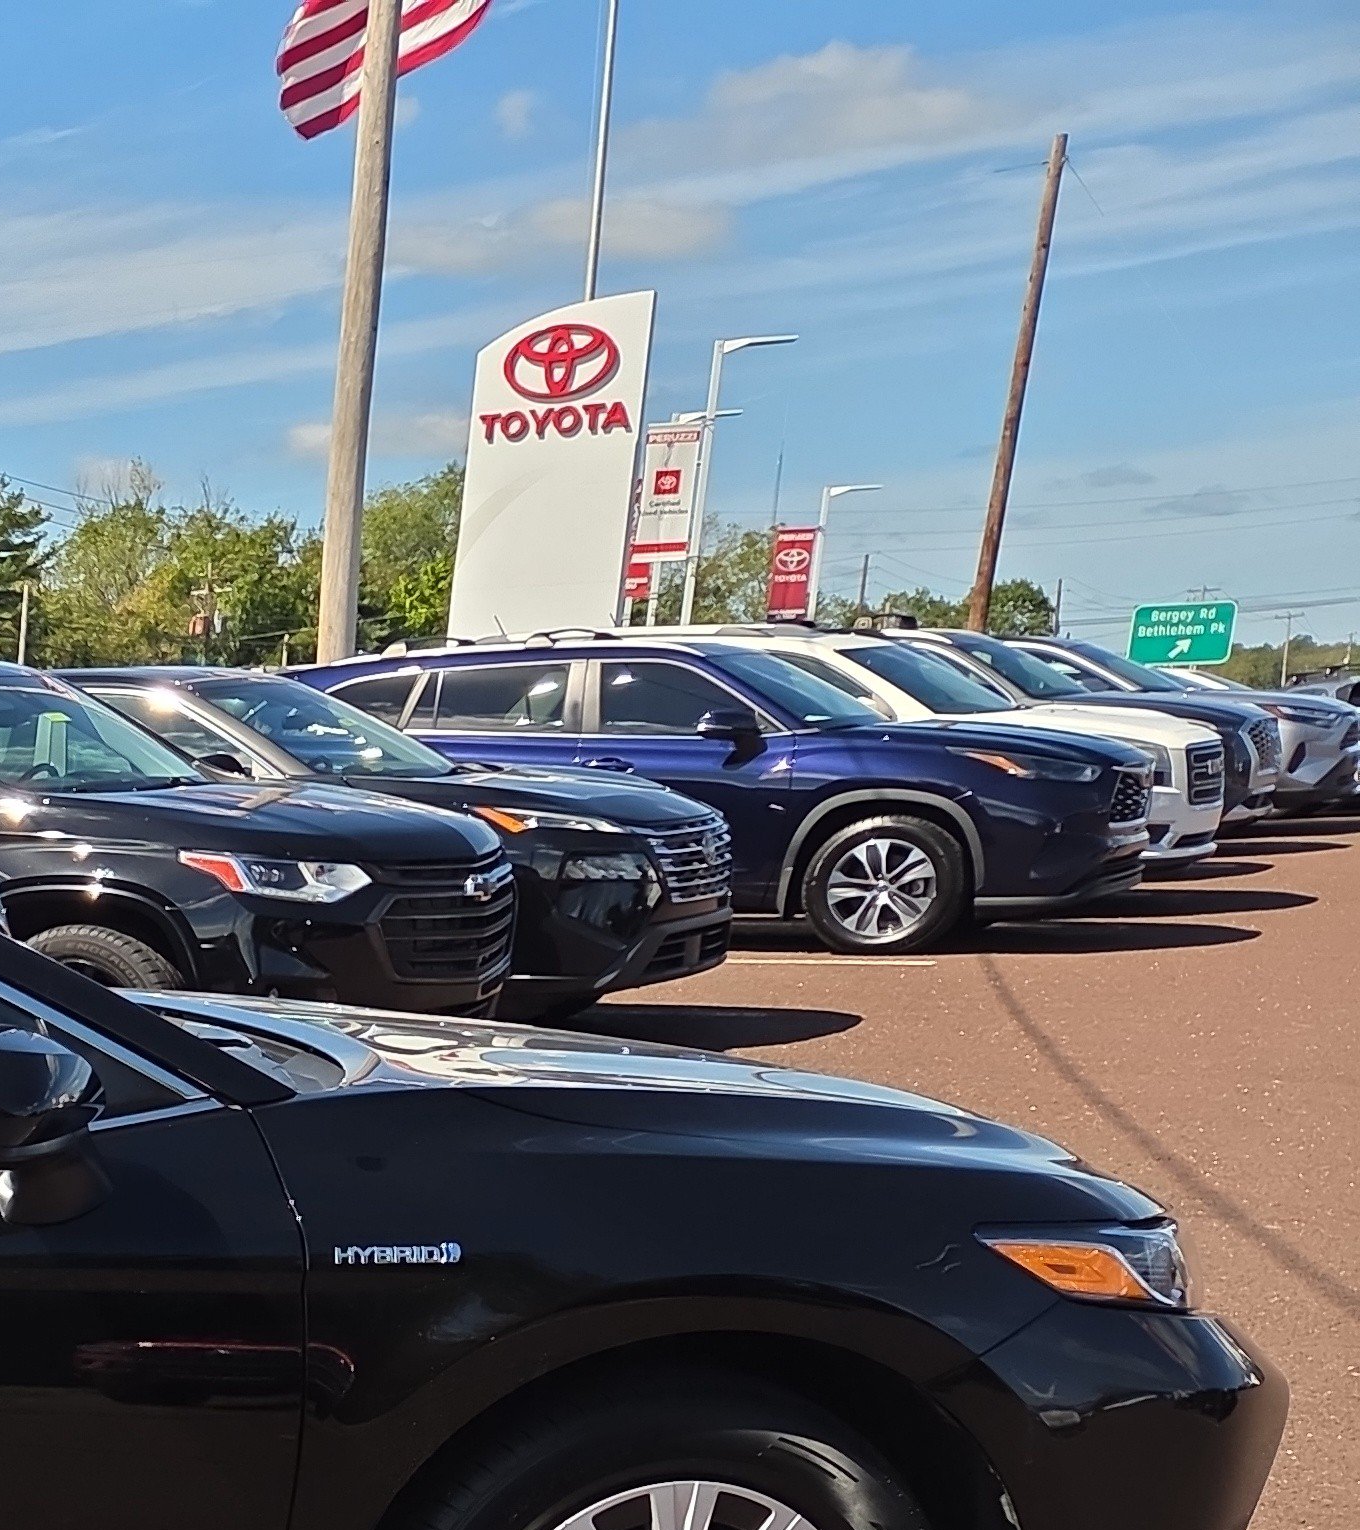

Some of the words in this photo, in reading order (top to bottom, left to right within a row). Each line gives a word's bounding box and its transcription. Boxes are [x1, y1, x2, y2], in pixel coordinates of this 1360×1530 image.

[479, 400, 632, 444] TOYOTA
[648, 432, 698, 444] PERUZZI
[774, 574, 808, 583] TOYOTA
[1151, 609, 1195, 624] Bergey
[1199, 606, 1217, 620] Rd
[1137, 623, 1205, 638] Bethlehem
[1210, 621, 1226, 634] Pk
[334, 1245, 443, 1265] HYBRID
